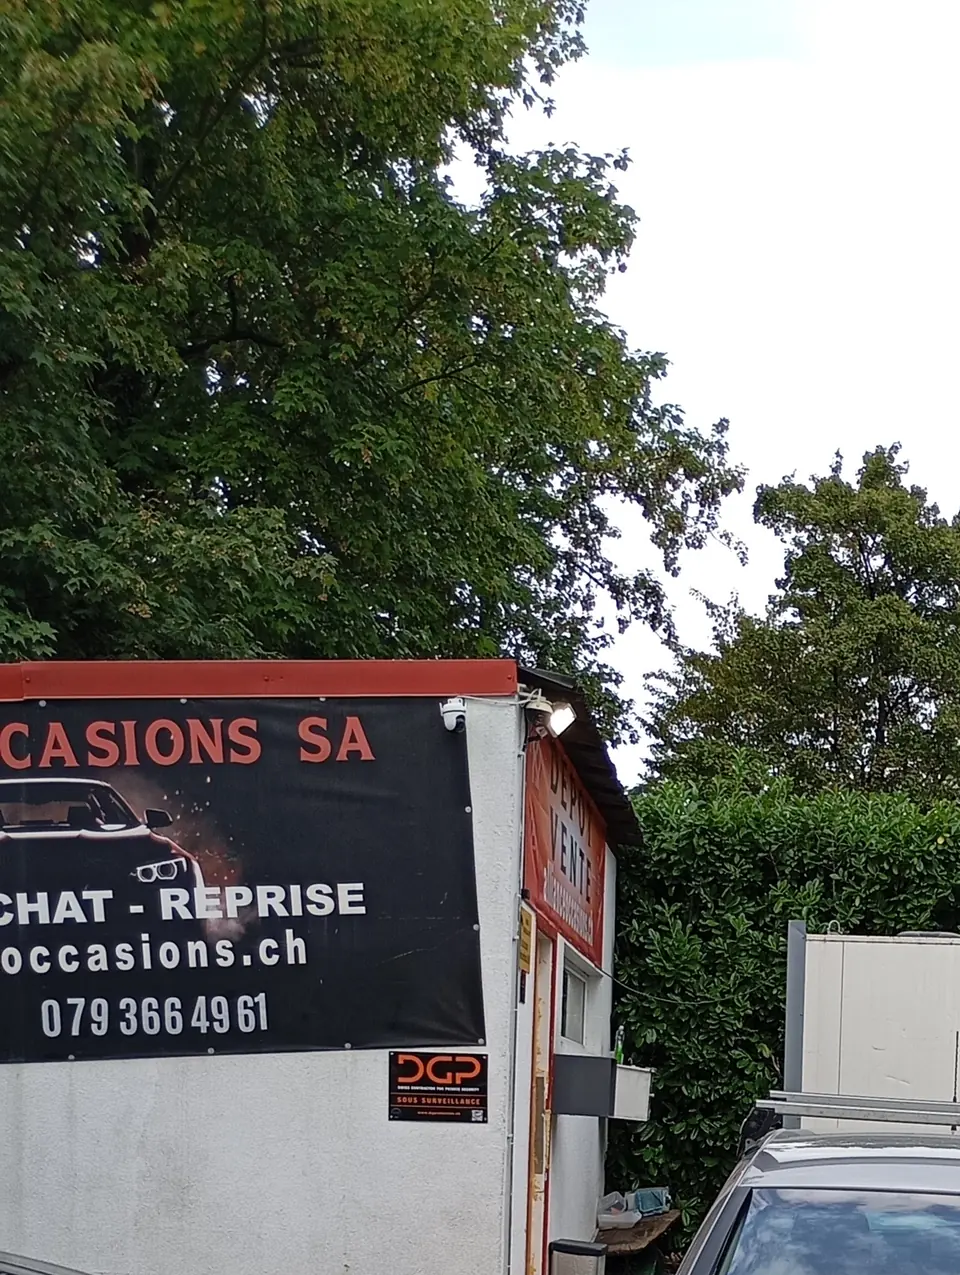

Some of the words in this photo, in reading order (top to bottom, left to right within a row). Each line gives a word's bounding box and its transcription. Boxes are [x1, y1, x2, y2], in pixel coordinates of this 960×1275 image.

[297, 716, 376, 763] SA
[550, 806, 592, 904] VENTE
[159, 883, 367, 921] REPRISE
[1, 929, 308, 975] occasions.ch
[41, 997, 110, 1038] 079
[119, 996, 183, 1036] 366
[190, 994, 231, 1034] 49
[236, 992, 269, 1033] 61
[398, 1054, 481, 1084] DGP
[396, 1096, 418, 1104] SOUS
[421, 1097, 481, 1106] SURVEILLANCE
